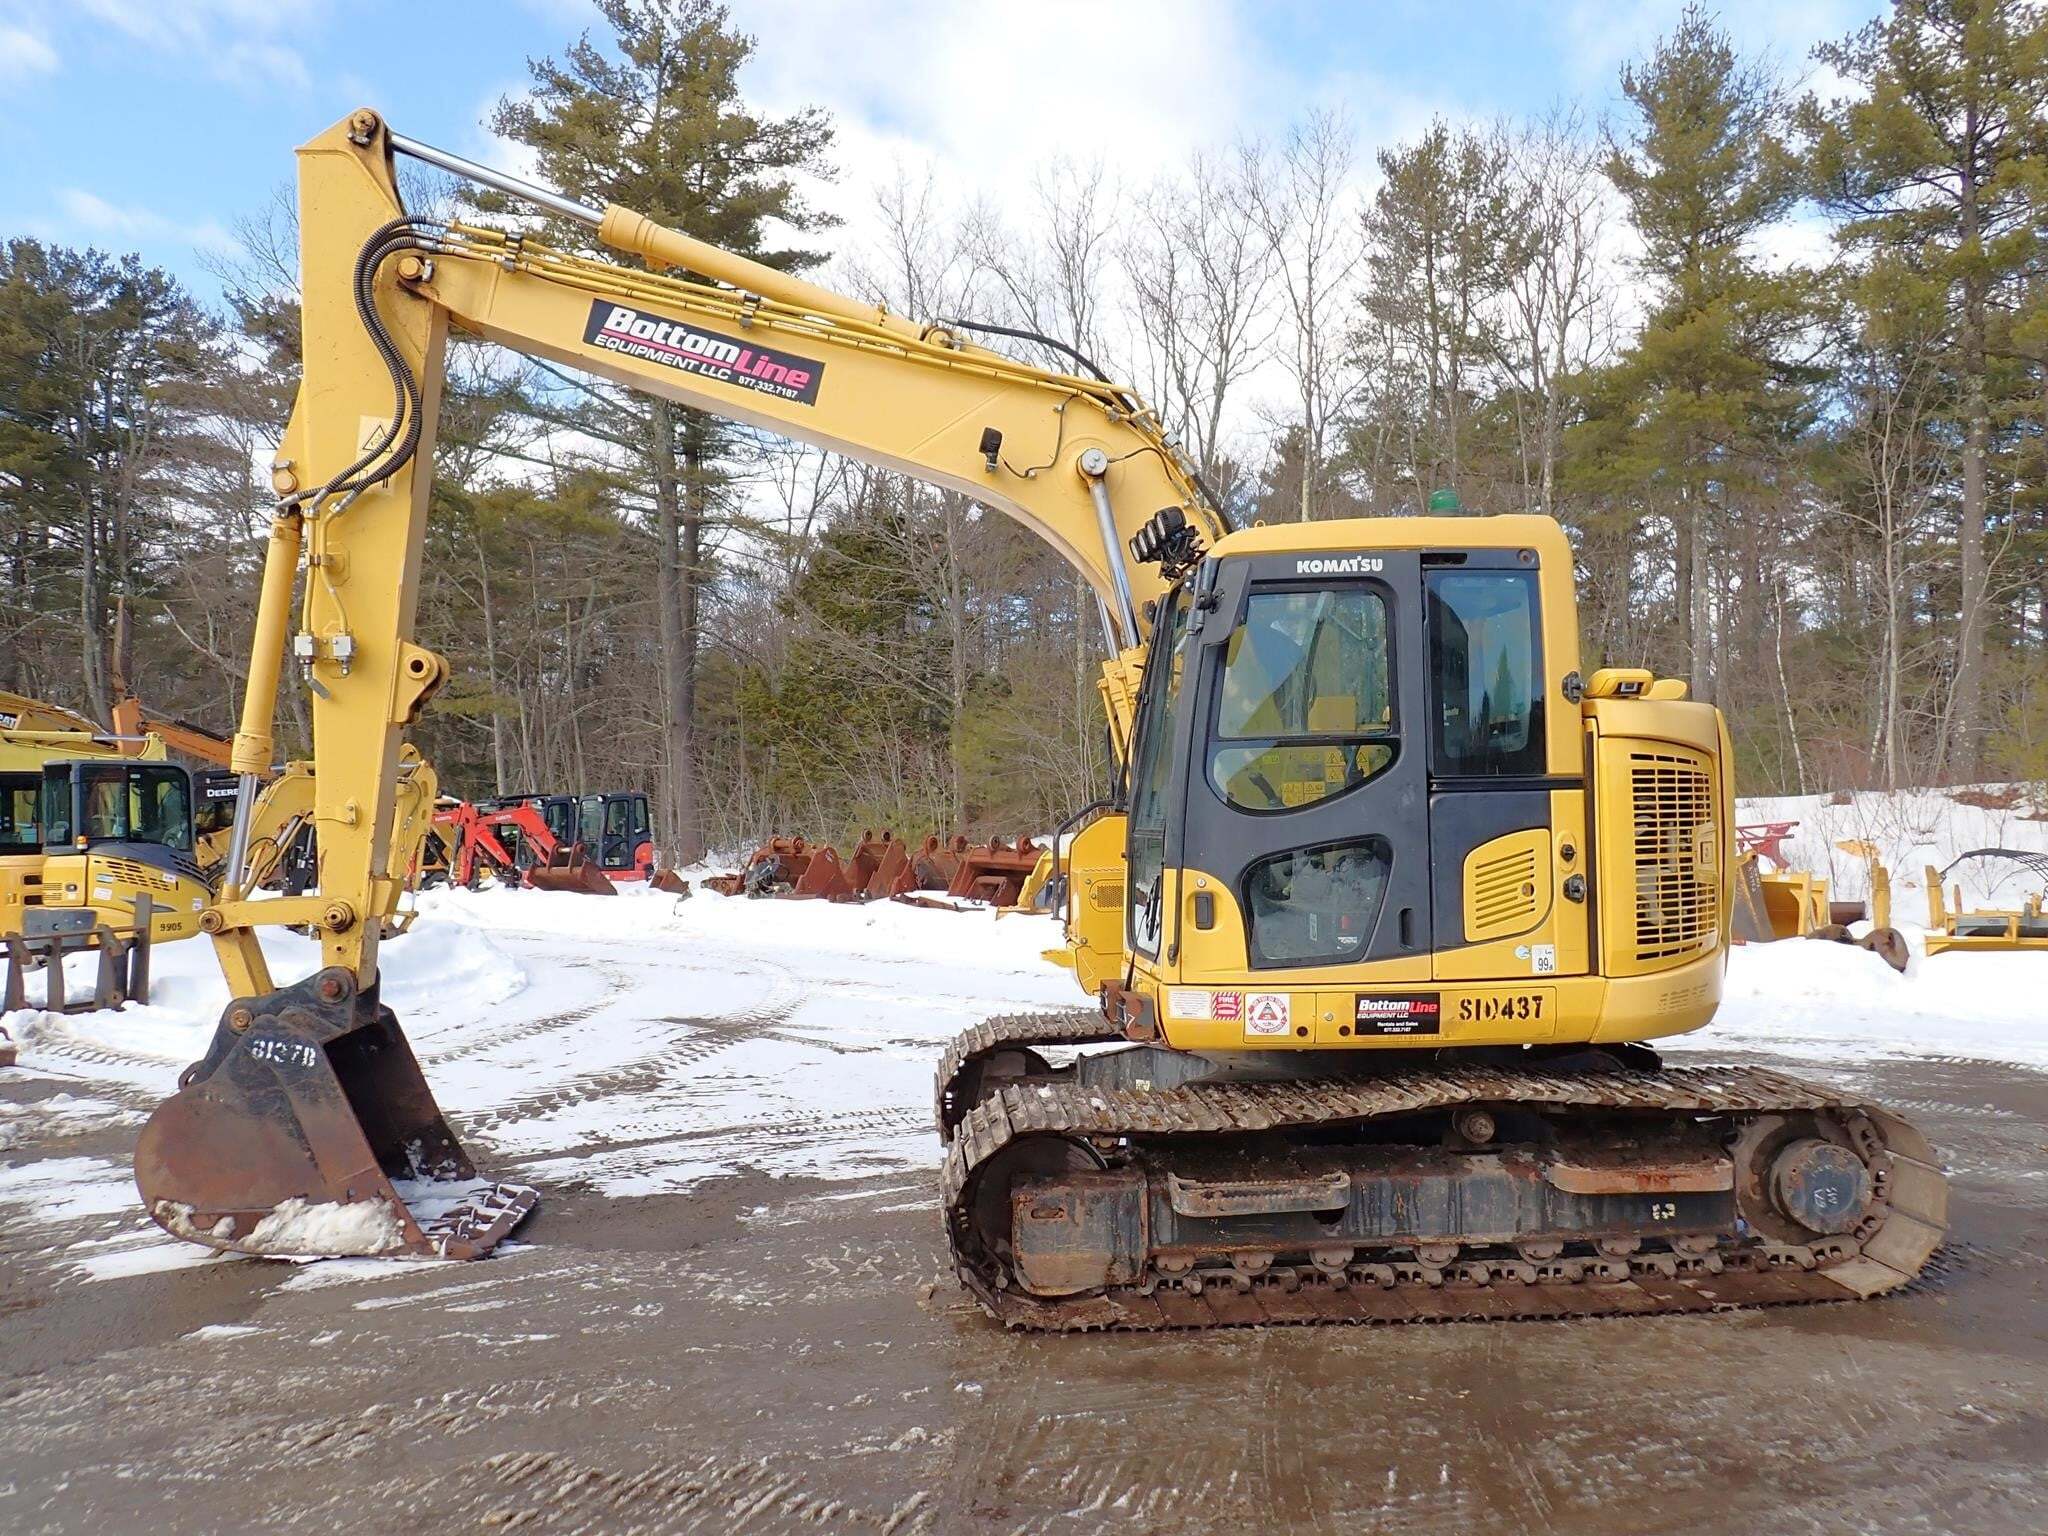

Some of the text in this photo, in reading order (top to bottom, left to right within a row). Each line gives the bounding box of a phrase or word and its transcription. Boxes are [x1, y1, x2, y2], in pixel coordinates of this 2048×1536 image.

[594, 334, 731, 380] EQUIPMENT LLC
[738, 375, 798, 398] 877.332.7187
[1296, 556, 1383, 573] KOMATSU
[207, 788, 239, 797] DEERE
[160, 922, 183, 931] 9905
